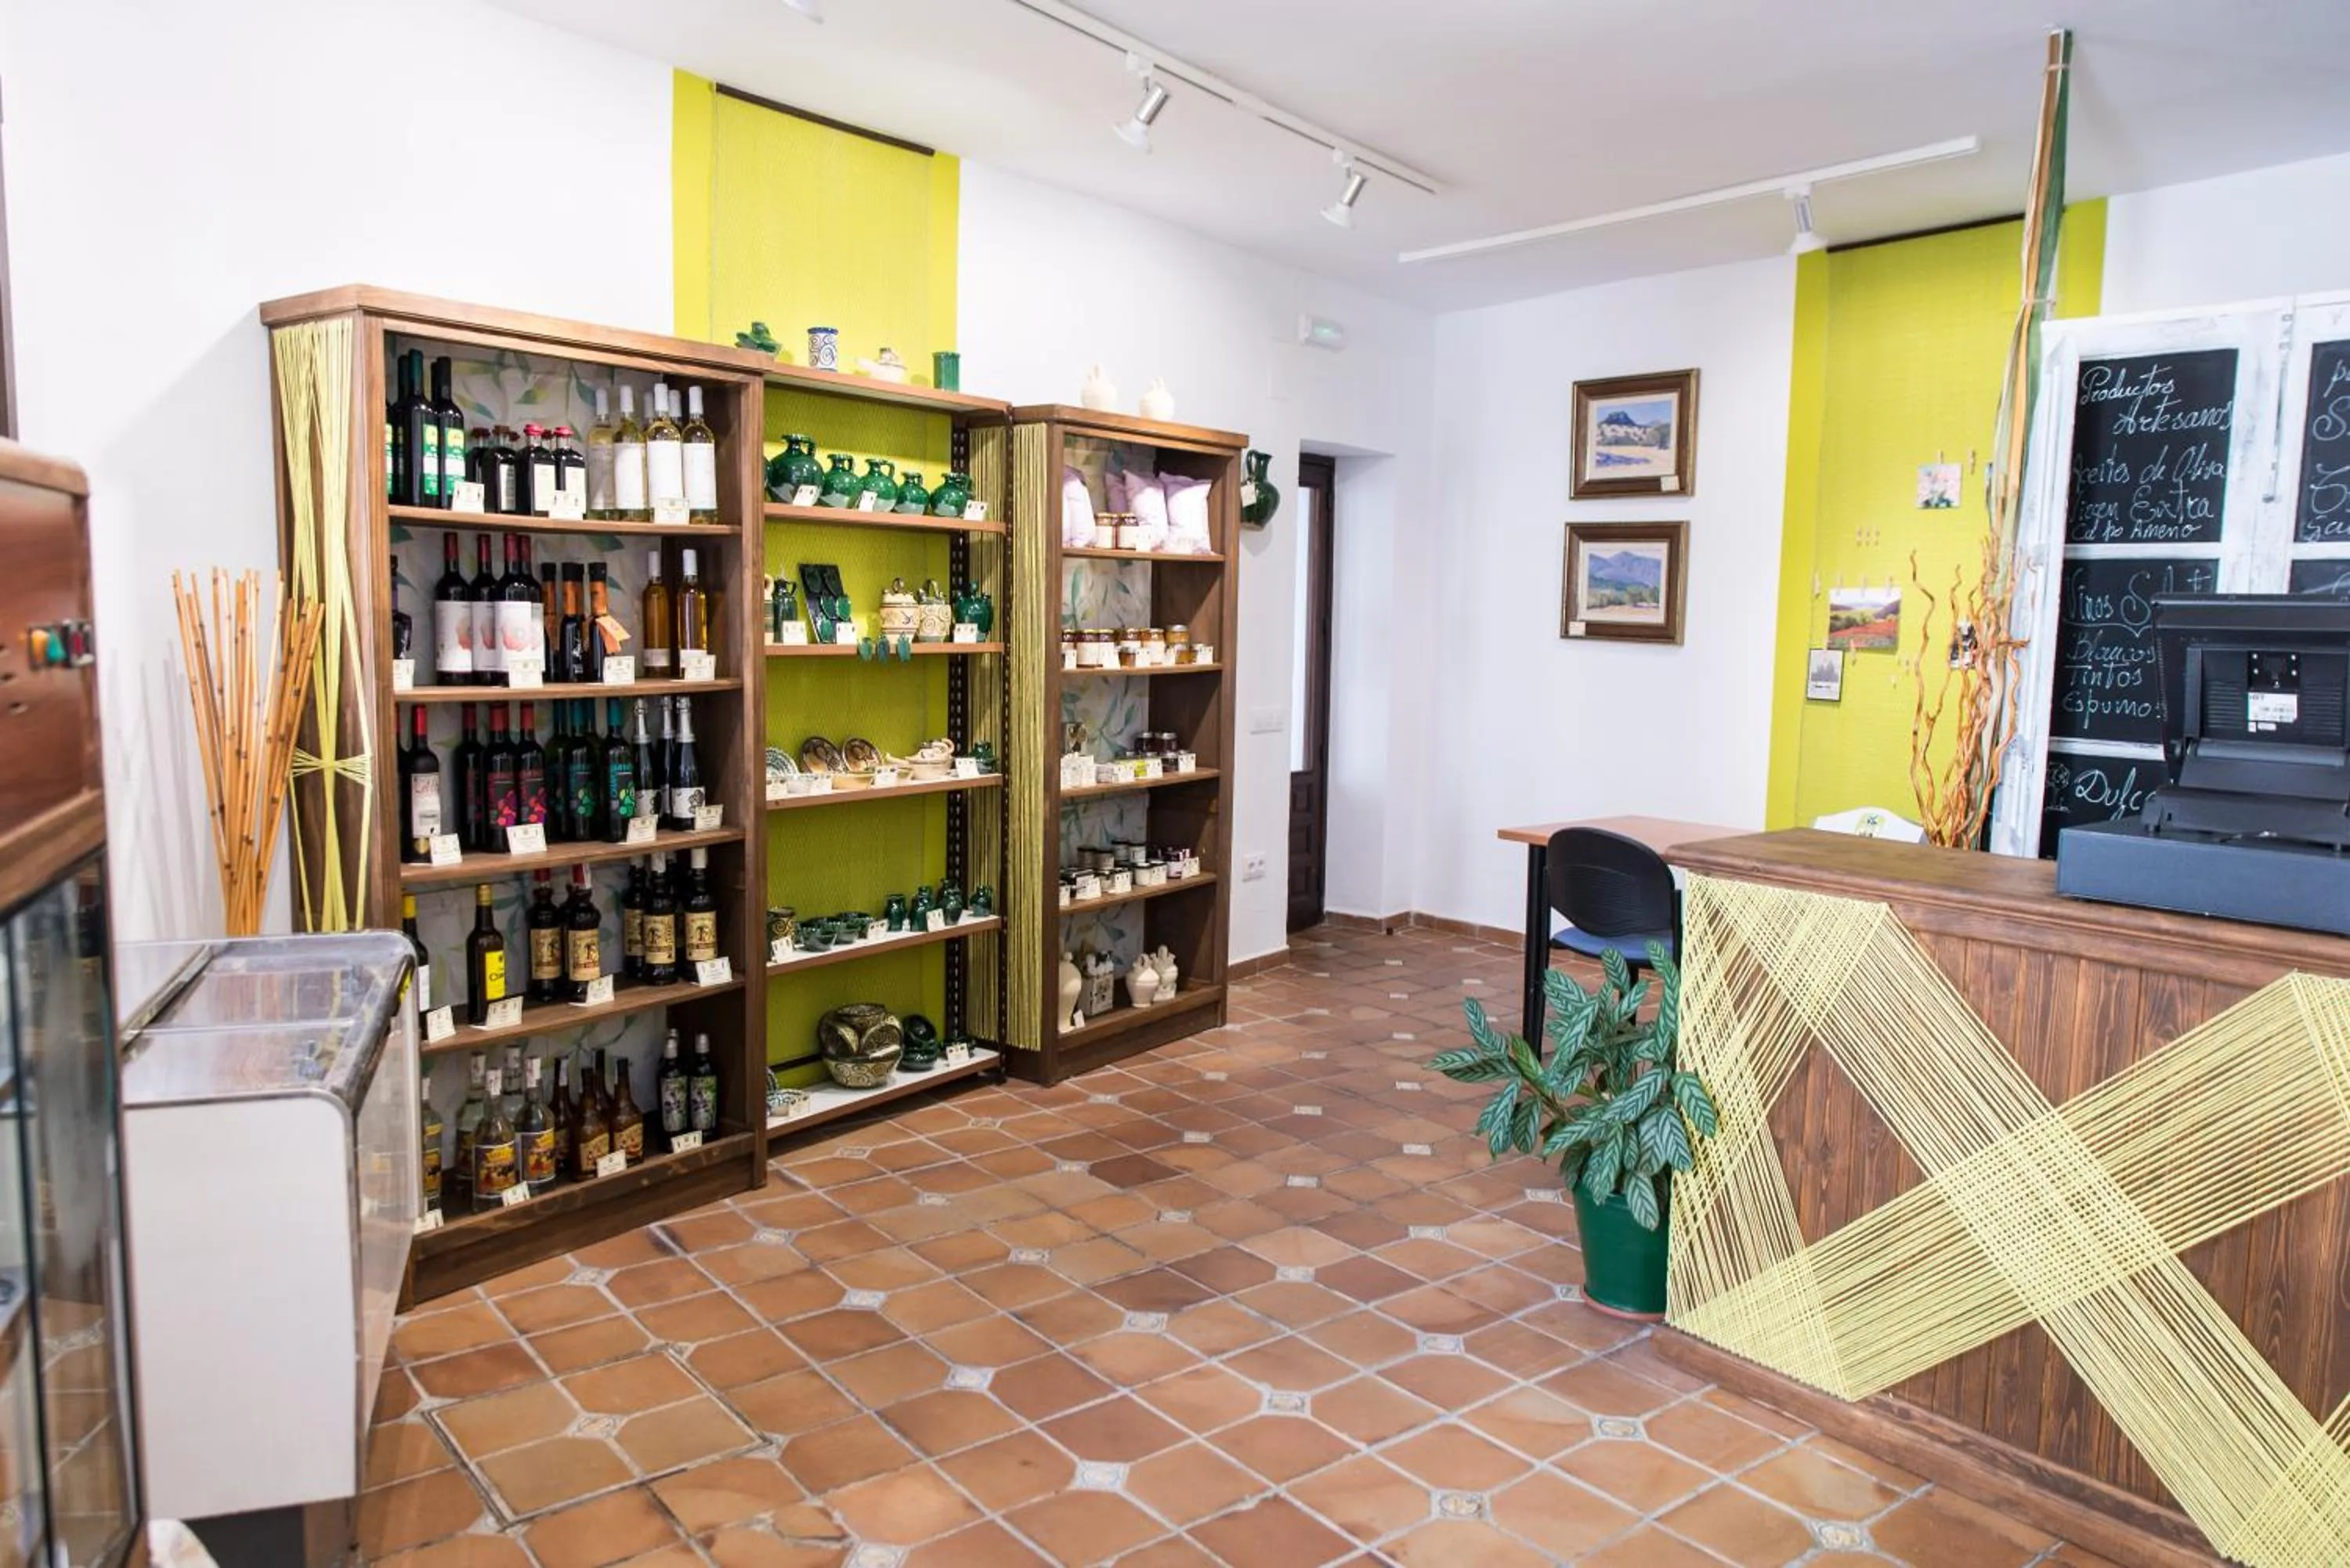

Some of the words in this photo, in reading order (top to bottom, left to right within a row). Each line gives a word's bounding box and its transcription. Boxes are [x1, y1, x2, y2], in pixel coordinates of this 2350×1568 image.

[2079, 364, 2174, 405] Productos
[2113, 395, 2232, 434] Artesanos
[2063, 662, 2143, 690] Tintos
